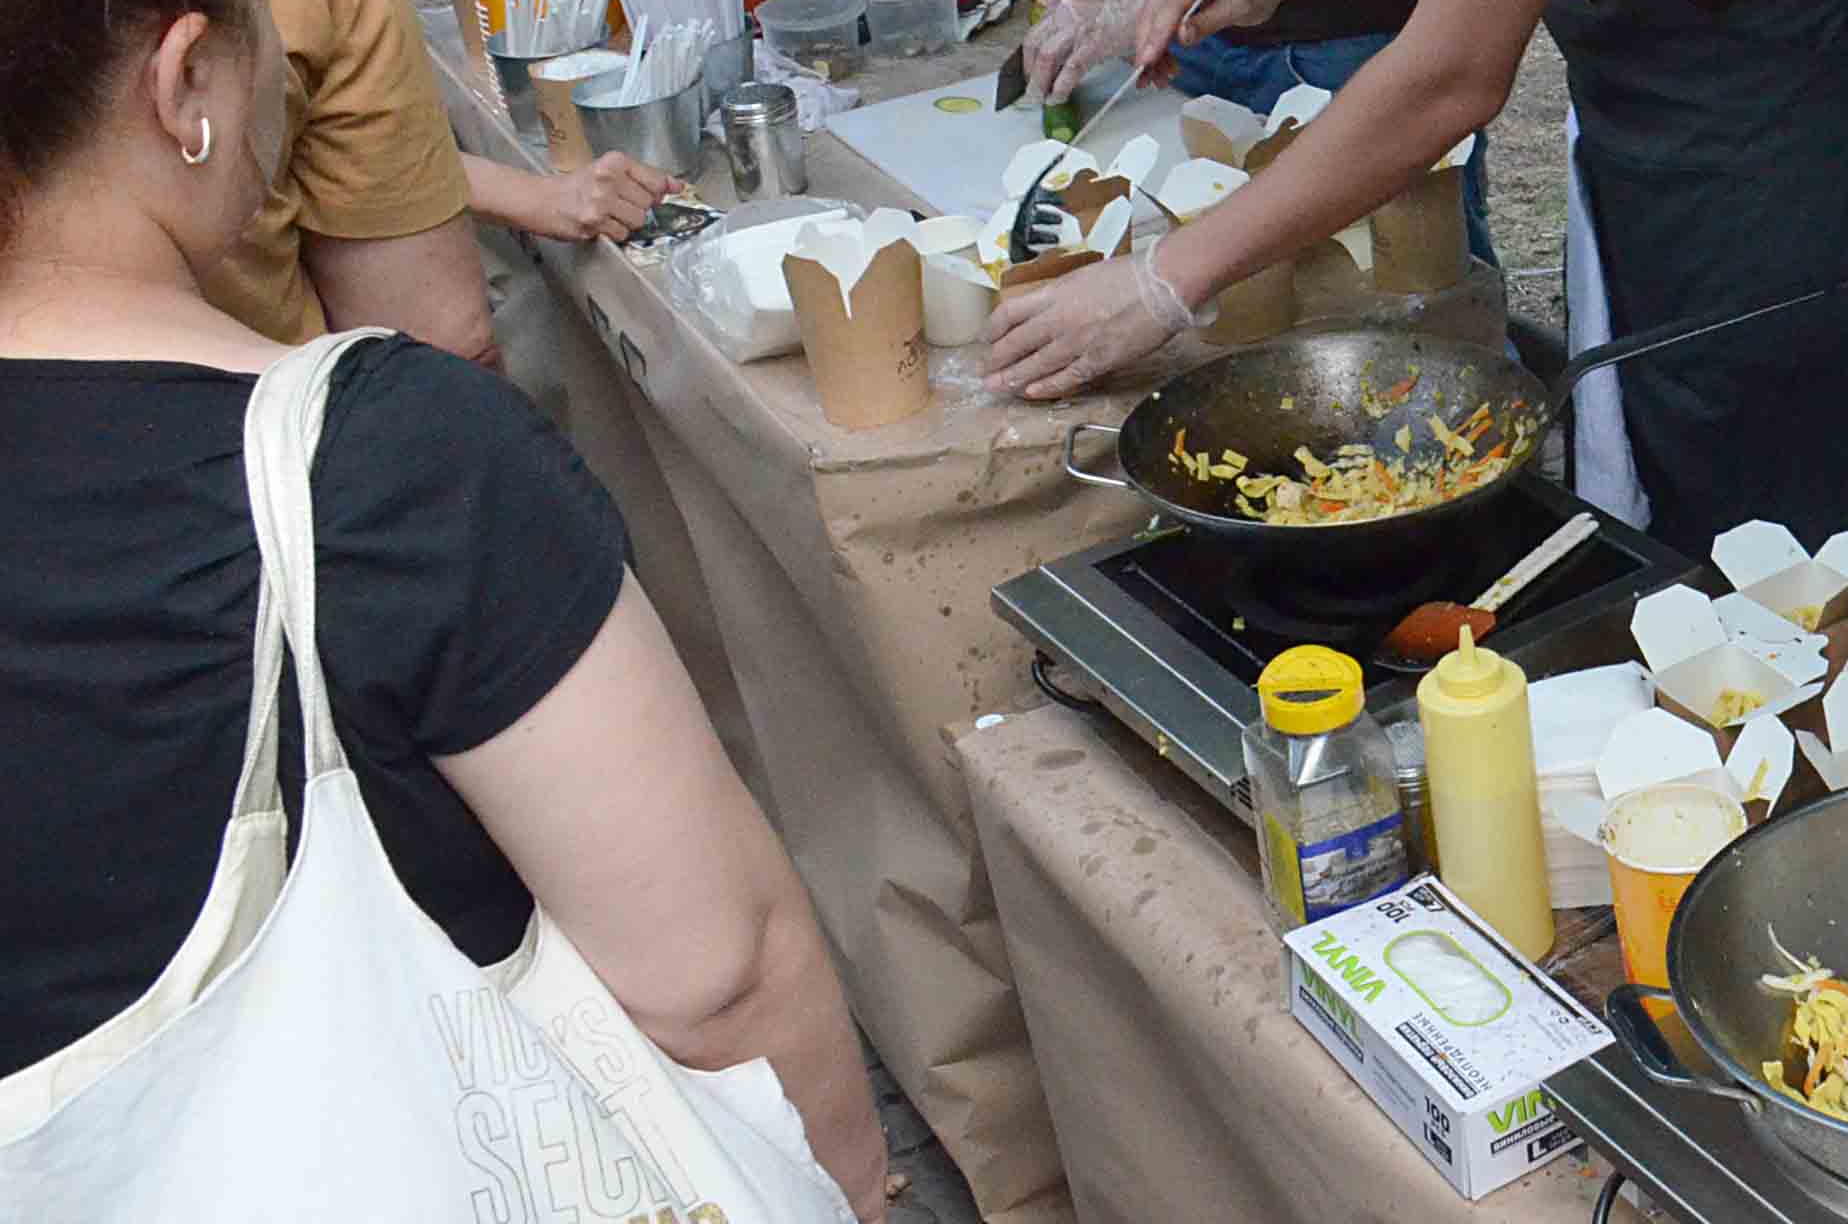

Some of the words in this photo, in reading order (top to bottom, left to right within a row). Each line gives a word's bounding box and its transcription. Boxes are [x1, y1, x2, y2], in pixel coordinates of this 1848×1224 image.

[1376, 891, 1413, 924] 100
[1311, 928, 1388, 1004] VINYL
[1424, 1095, 1451, 1132] 100
